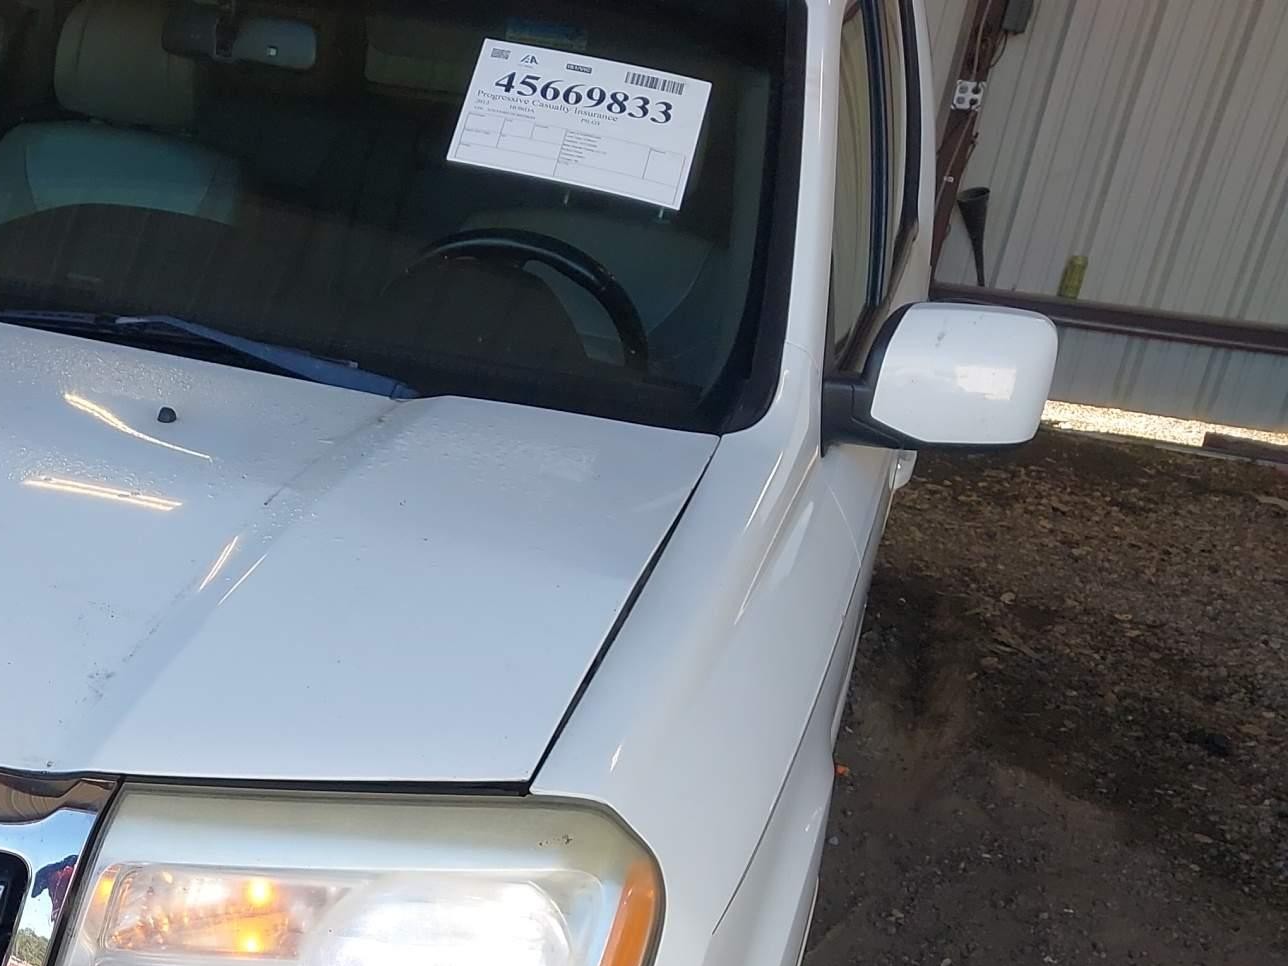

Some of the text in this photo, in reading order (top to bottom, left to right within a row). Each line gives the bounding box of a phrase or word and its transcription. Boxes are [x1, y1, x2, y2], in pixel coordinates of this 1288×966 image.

[477, 89, 530, 105] Progressive
[532, 99, 571, 114] Casualty
[574, 106, 619, 122] Insurance
[494, 71, 674, 124] 45669833
